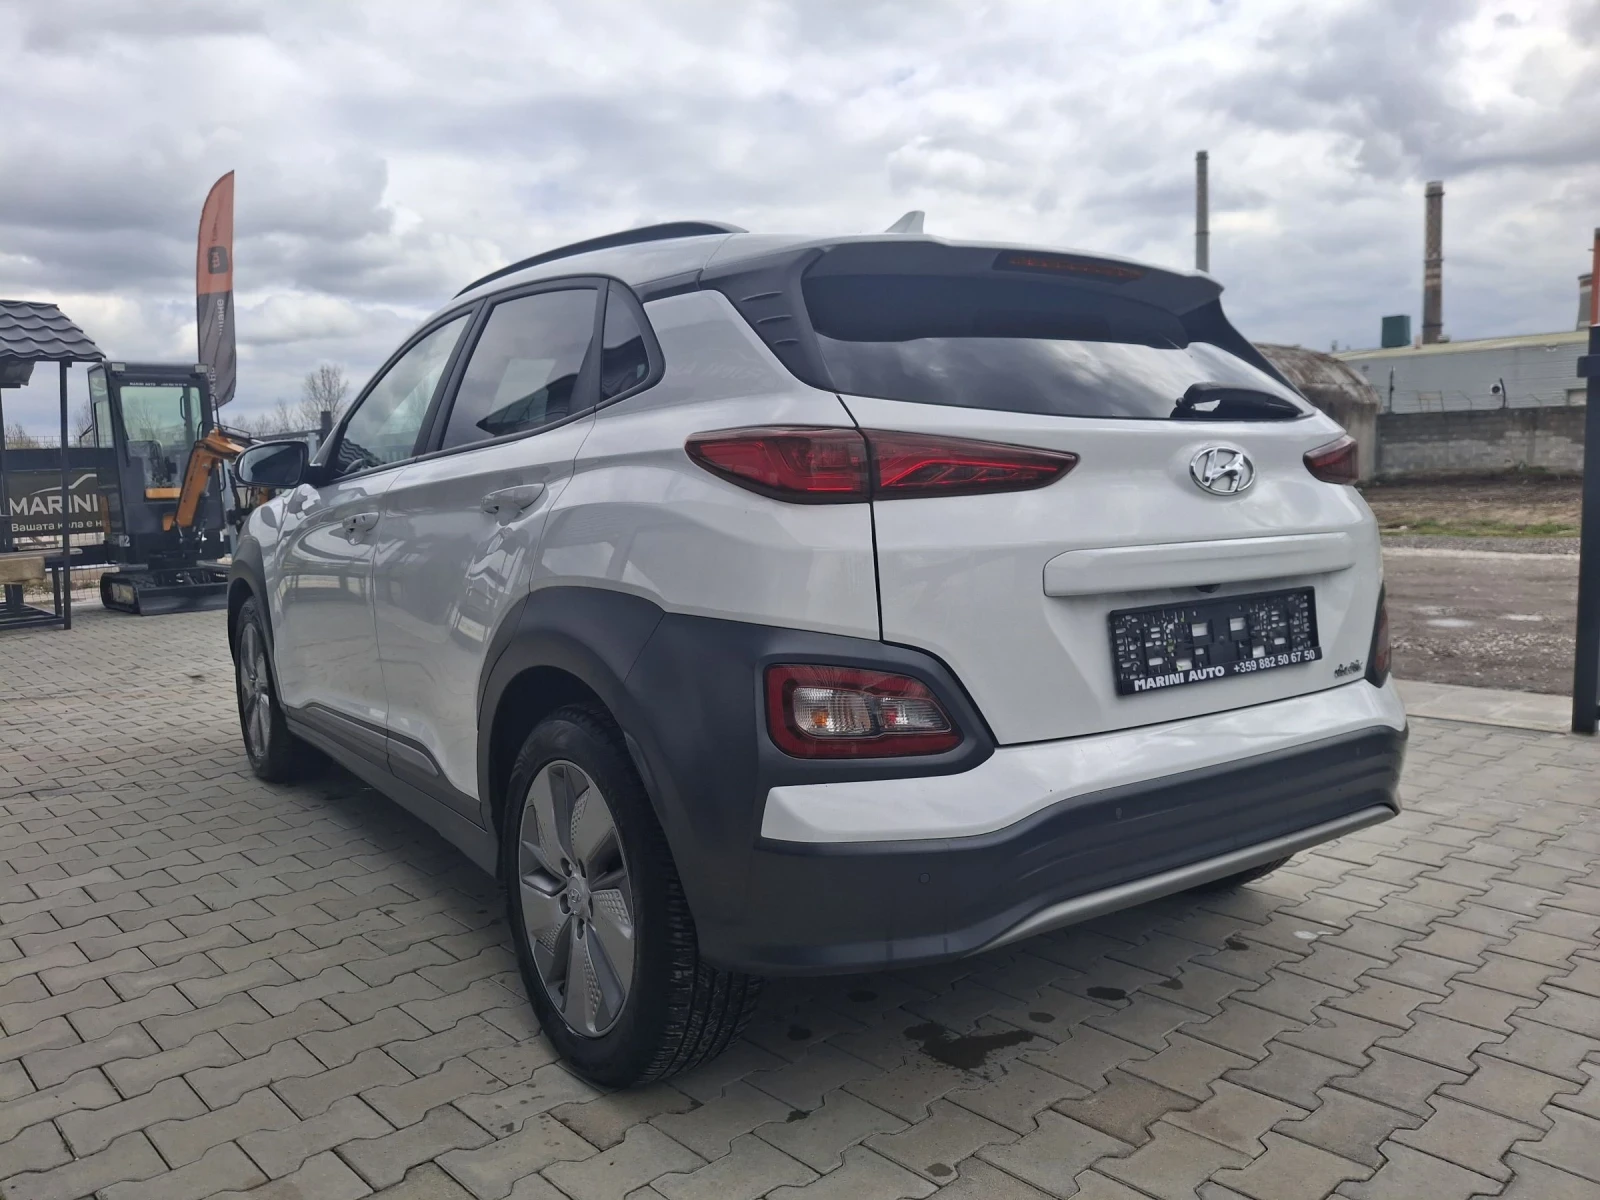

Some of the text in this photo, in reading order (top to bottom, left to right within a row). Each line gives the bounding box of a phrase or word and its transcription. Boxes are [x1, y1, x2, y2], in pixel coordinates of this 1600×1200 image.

[9, 493, 99, 516] MARINI
[11, 521, 55, 532] Вашата
[57, 519, 83, 530] кла
[1134, 649, 1316, 691] MARINI AUTO +359 882 50 67 50
